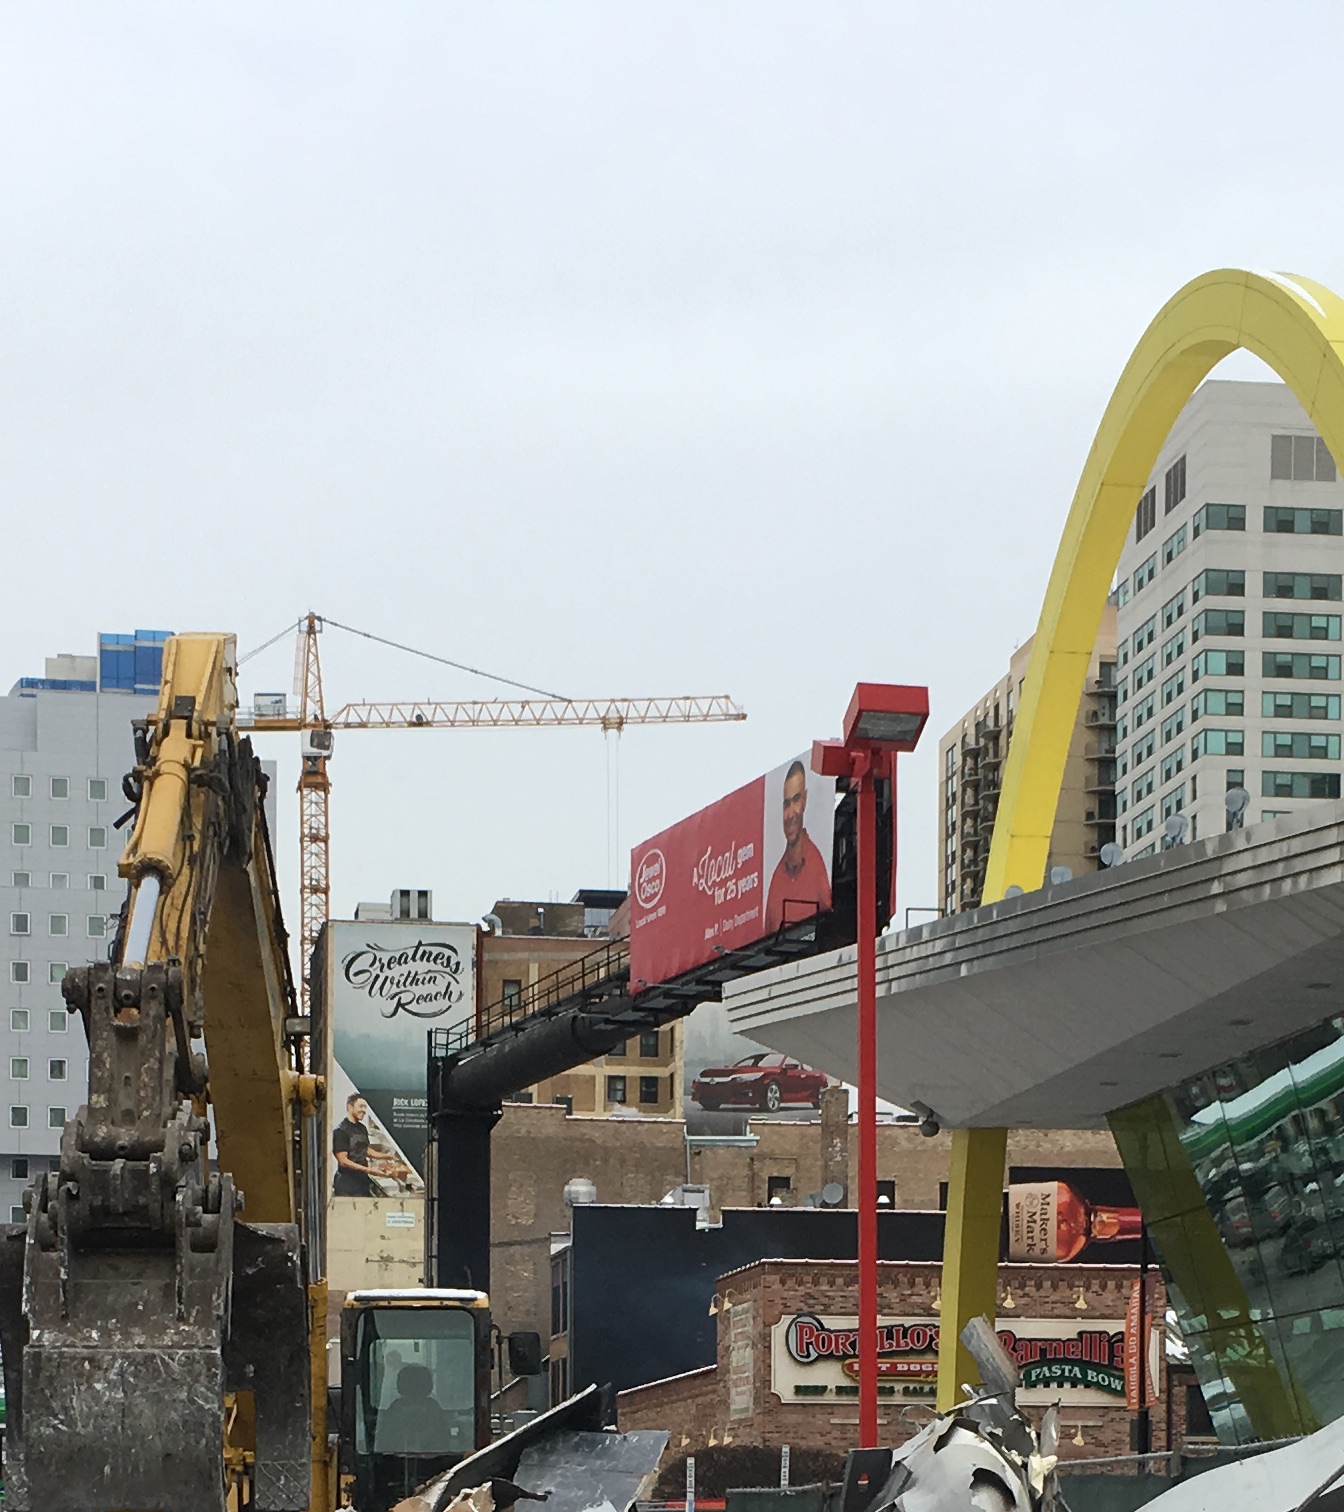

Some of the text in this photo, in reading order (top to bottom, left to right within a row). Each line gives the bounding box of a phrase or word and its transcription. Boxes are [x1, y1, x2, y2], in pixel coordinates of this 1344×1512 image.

[640, 857, 662, 883] Jewel
[698, 840, 736, 895] Local
[641, 879, 661, 900] Osco
[737, 871, 759, 899] years
[342, 940, 464, 988] Greatness
[368, 970, 449, 998] Within
[380, 981, 464, 1018] Reach
[1026, 1210, 1038, 1254] Mark
[1039, 1192, 1052, 1255] Maker's
[795, 1322, 940, 1356] PORLLO'S
[1030, 1365, 1083, 1382] PASTA
[1087, 1369, 1125, 1391] BOW
